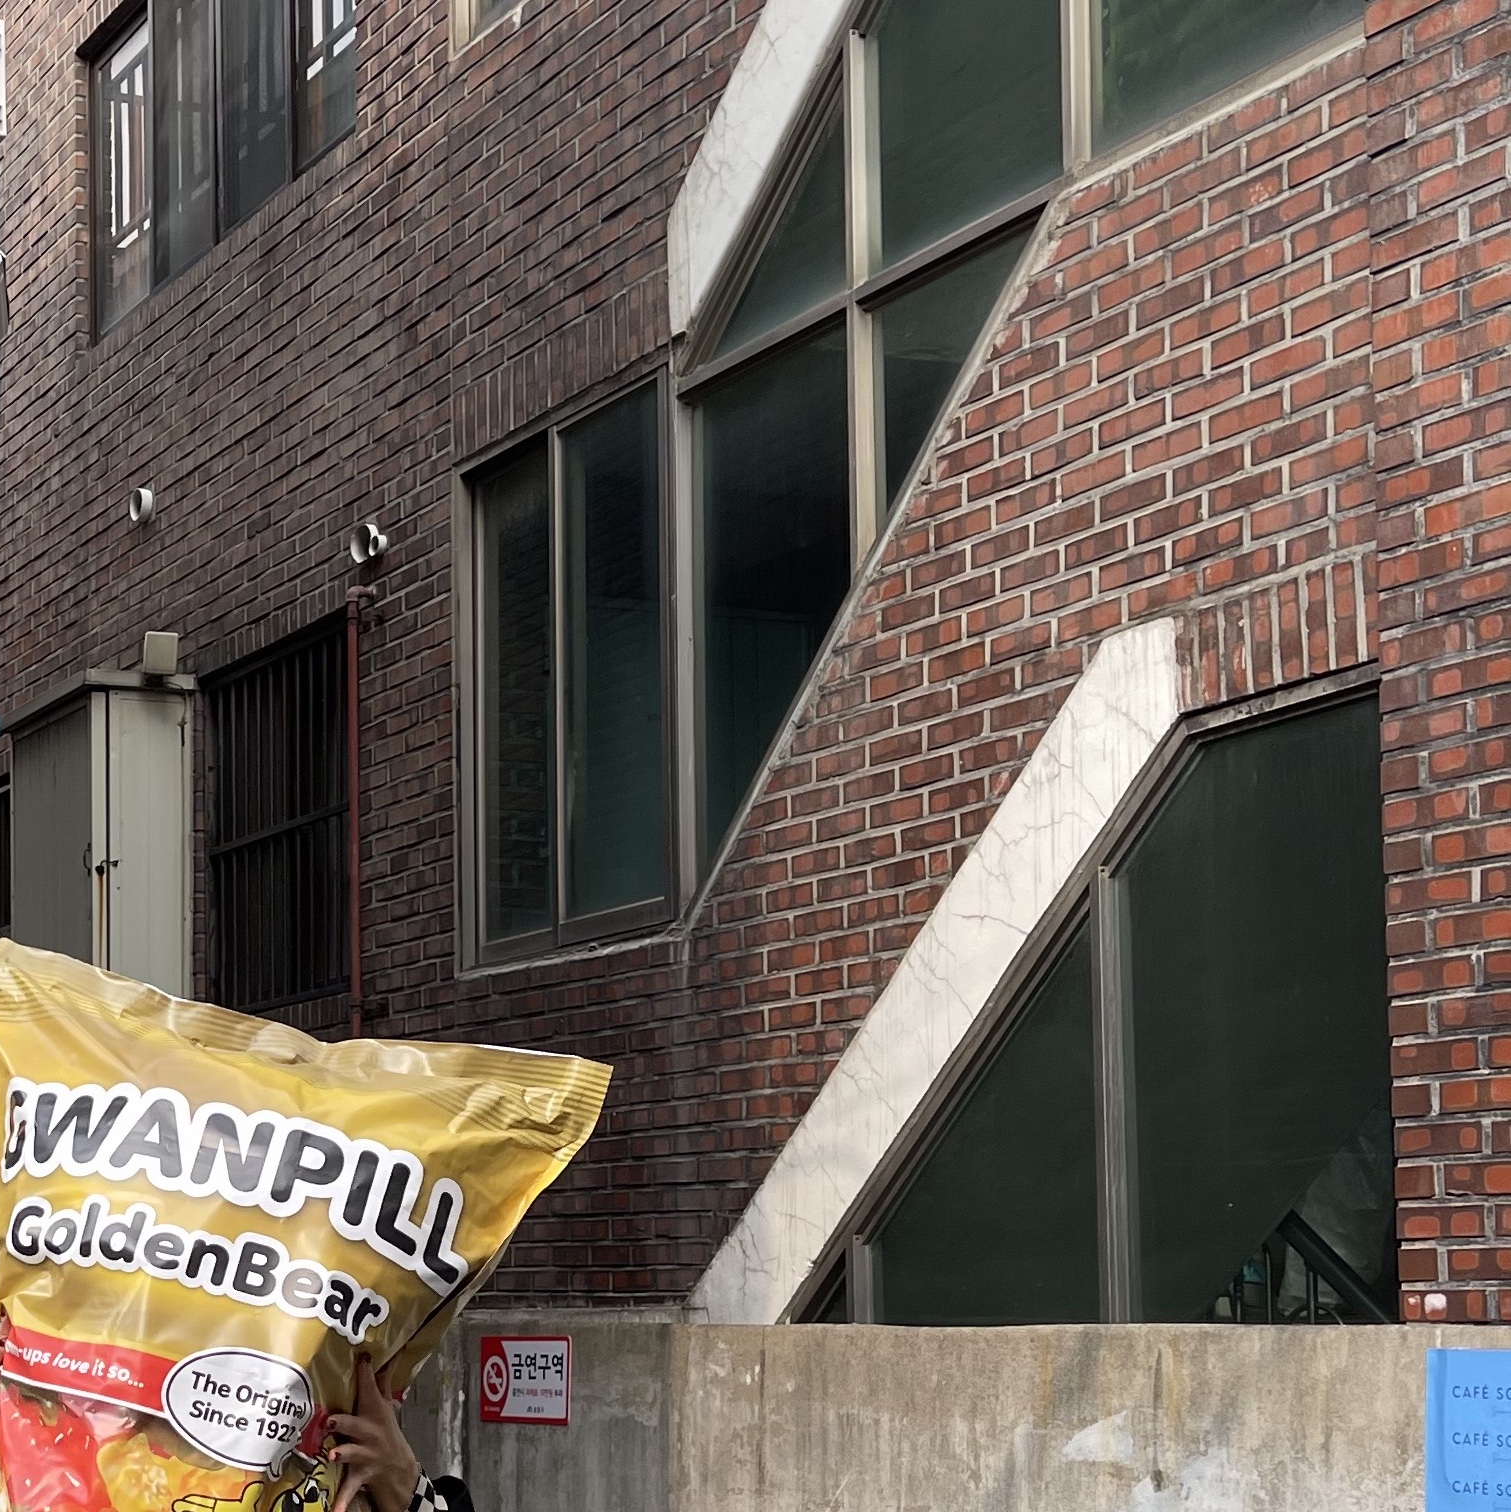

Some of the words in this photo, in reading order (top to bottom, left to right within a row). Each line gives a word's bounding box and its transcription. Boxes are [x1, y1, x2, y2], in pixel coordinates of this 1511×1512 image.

[11, 1201, 382, 1336] GoldenBear
[52, 1352, 90, 1374] love
[91, 1358, 106, 1377] it
[106, 1364, 145, 1388] so...
[511, 1352, 564, 1381] 금연구역
[191, 1370, 231, 1398] The
[1452, 1383, 1489, 1400] CAFÉ
[189, 1400, 249, 1431] Since
[1452, 1430, 1489, 1447] CAFÉ
[1452, 1480, 1489, 1496] CAFÉ
